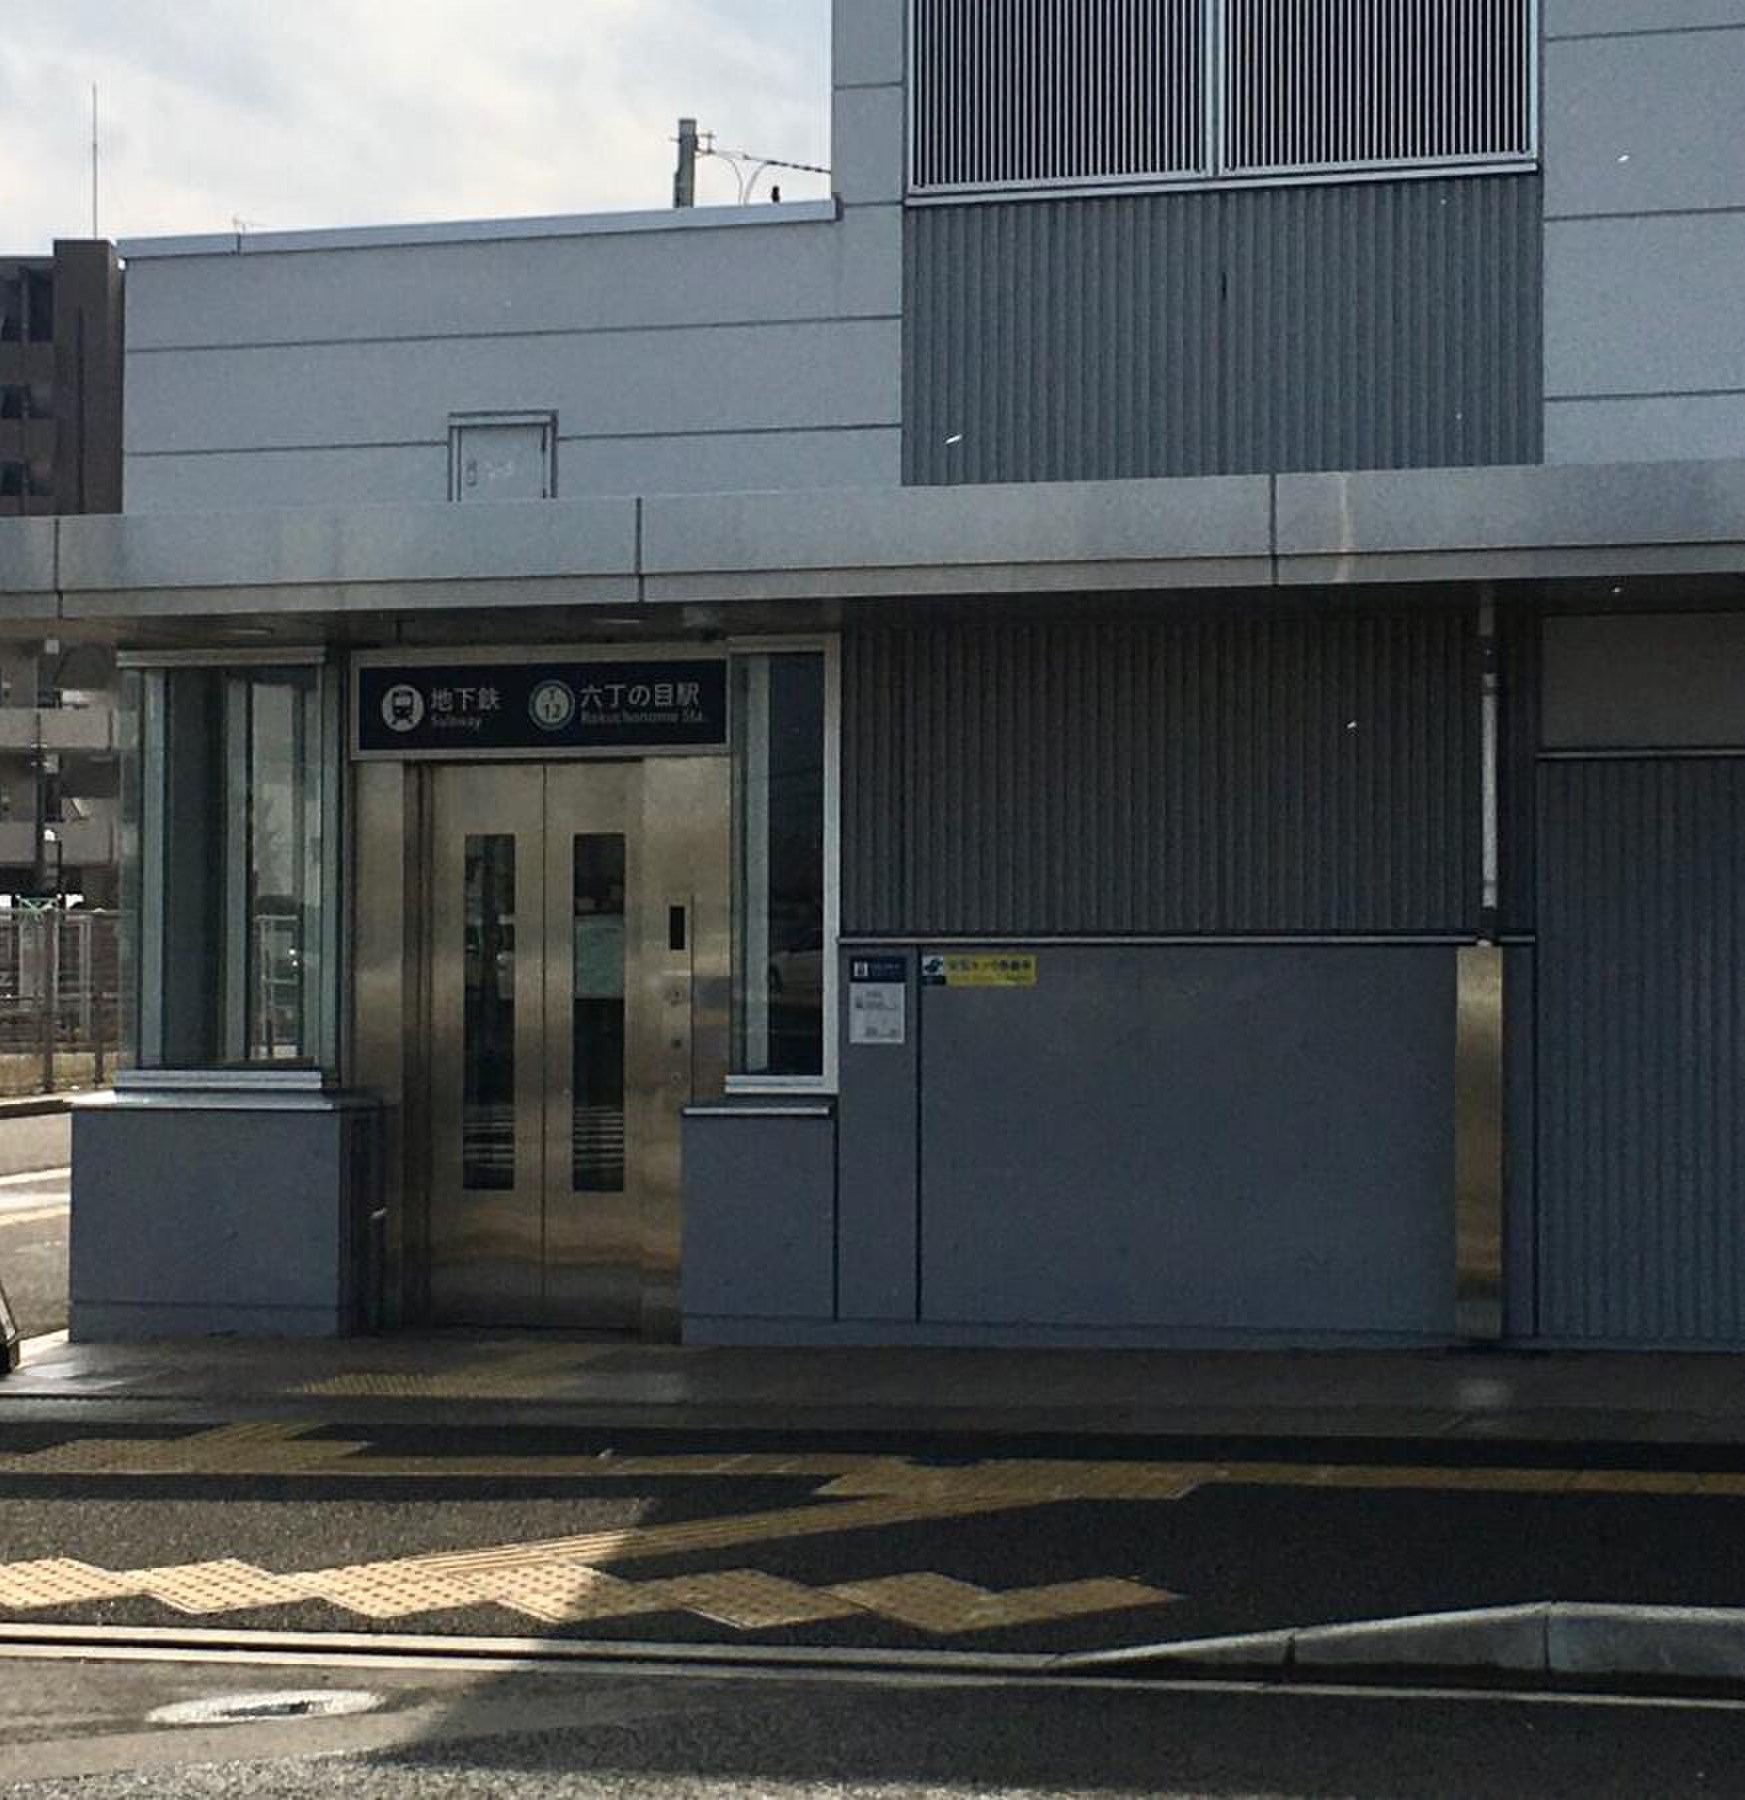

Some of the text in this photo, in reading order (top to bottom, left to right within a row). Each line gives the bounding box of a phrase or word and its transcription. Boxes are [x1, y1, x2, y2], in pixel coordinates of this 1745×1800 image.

[431, 683, 700, 711] 地下鉄 六丁の目駅
